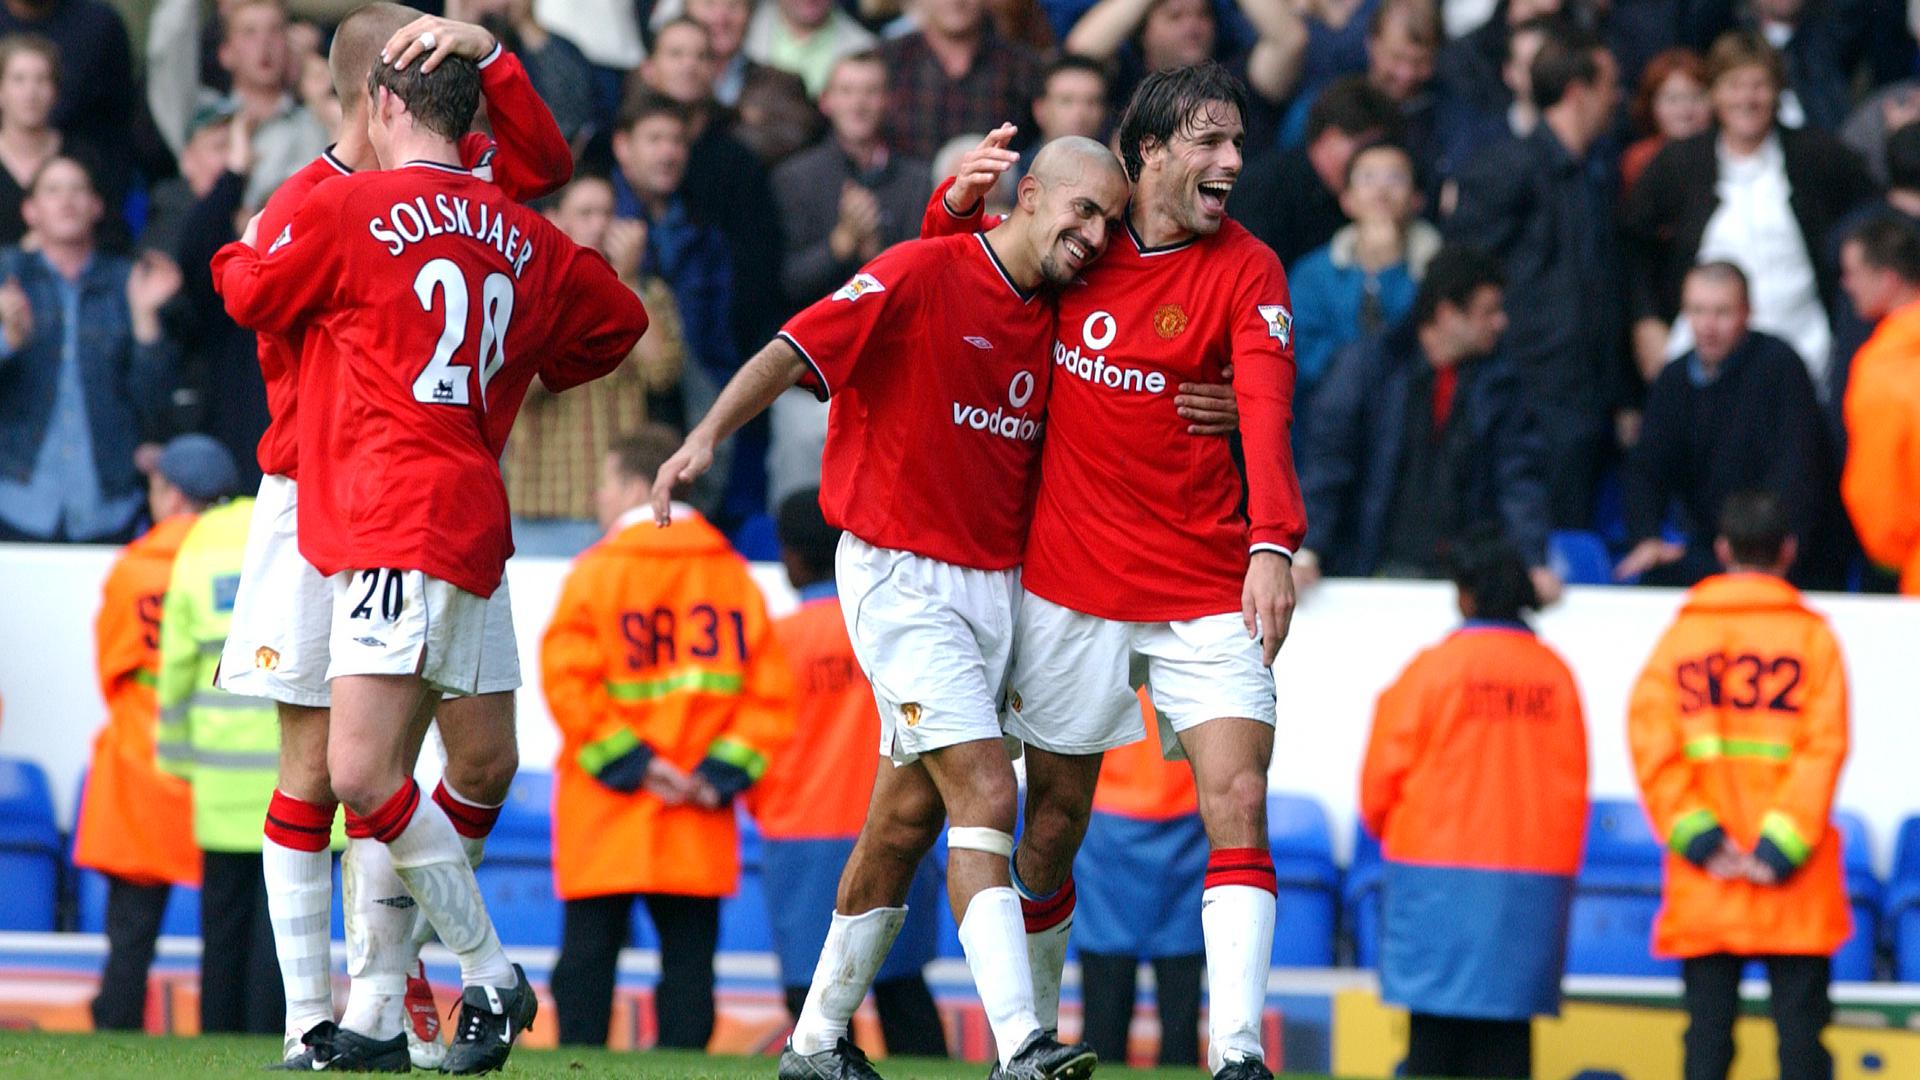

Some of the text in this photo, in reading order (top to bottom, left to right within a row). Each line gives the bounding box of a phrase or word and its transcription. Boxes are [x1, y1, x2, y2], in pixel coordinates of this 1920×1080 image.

[369, 193, 533, 279] SOLSKJAER
[412, 257, 514, 415] 20
[350, 567, 404, 621] 20
